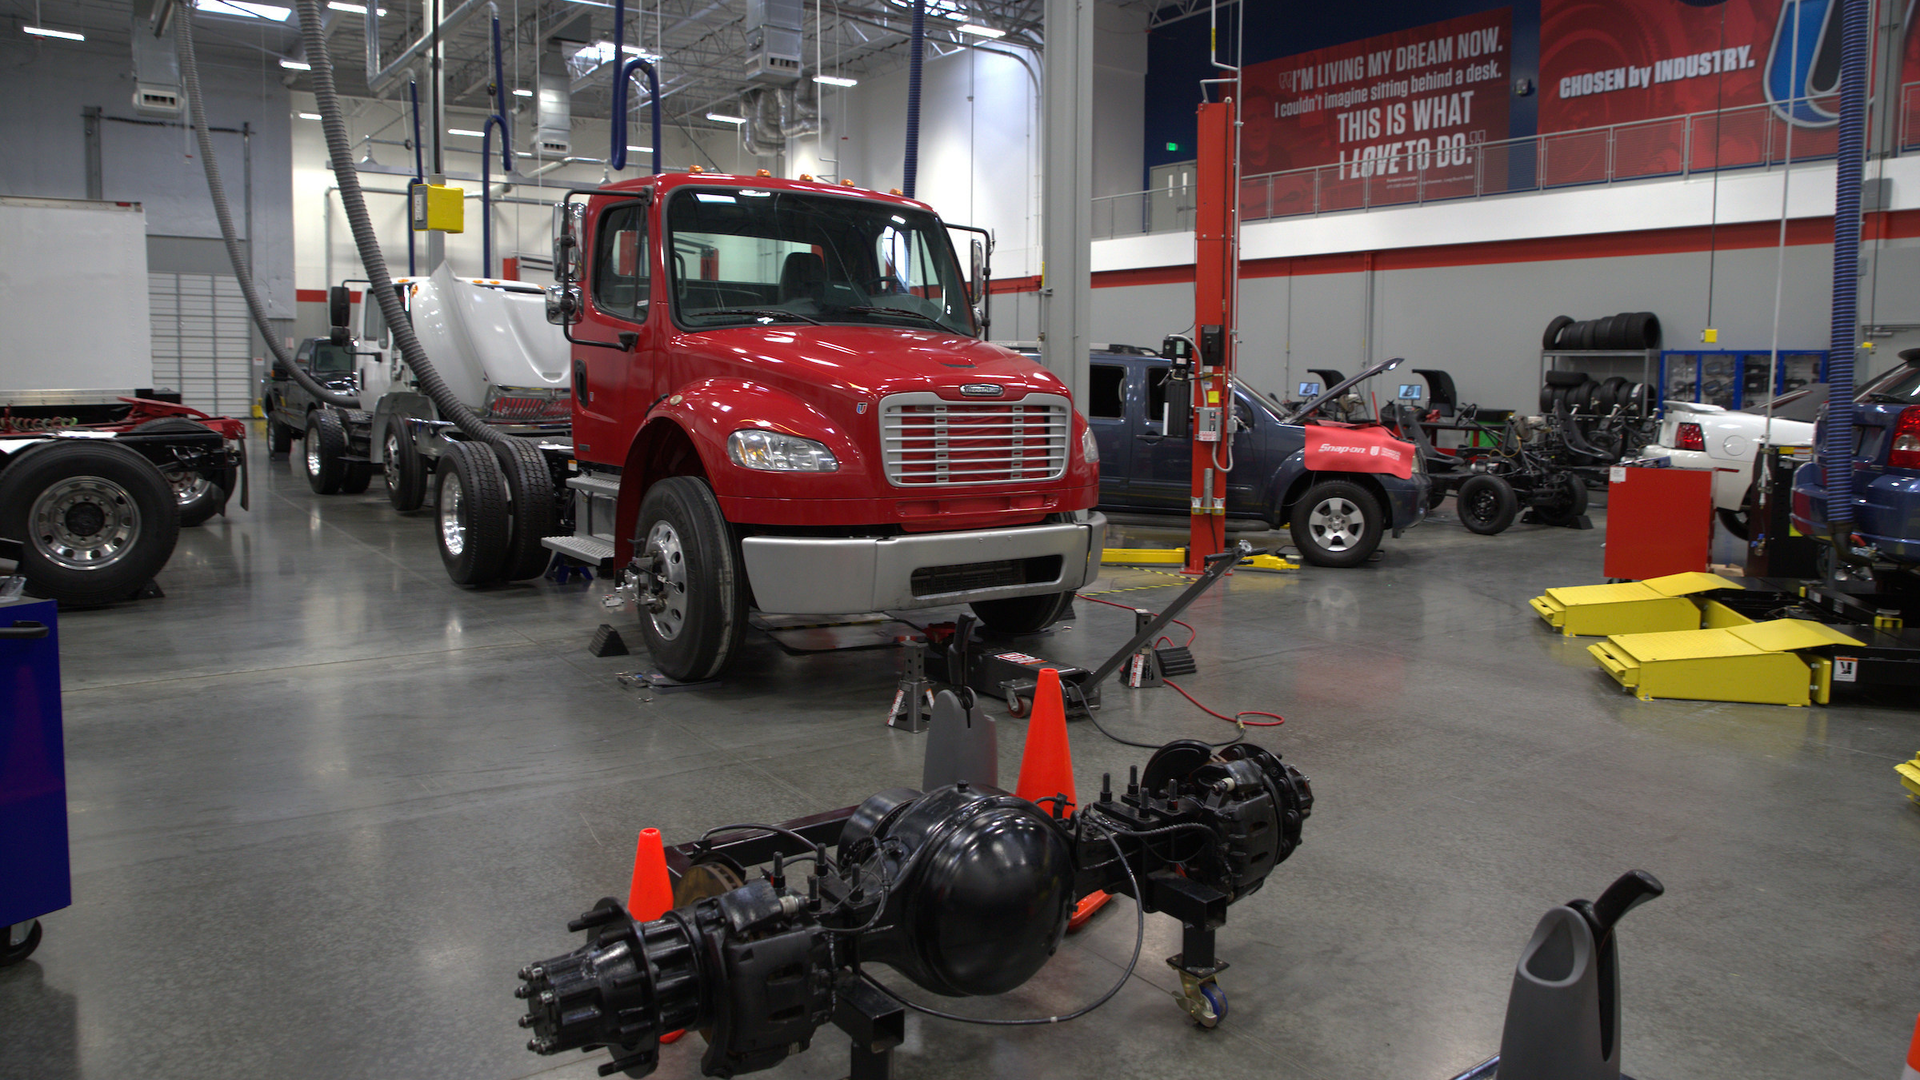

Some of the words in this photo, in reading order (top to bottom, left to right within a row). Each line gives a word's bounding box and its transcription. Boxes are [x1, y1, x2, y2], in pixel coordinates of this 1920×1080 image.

[1317, 56, 1364, 88] LIVING
[1368, 49, 1393, 78] MY
[1396, 36, 1453, 72] DREAM
[1457, 26, 1503, 60] NOW.
[1559, 67, 1626, 99] CHOSEN
[1628, 65, 1653, 89] by
[1654, 44, 1755, 84] INDUSTRY.
[1274, 102, 1279, 118] I
[1280, 94, 1322, 118] couldn't
[1324, 87, 1368, 109] imagine
[1370, 79, 1408, 99] sitting
[1411, 68, 1453, 94] behind
[1455, 70, 1464, 85] a
[1466, 59, 1502, 83] desk.
[1337, 107, 1381, 143] THIS
[1386, 102, 1406, 136] IS
[1412, 90, 1475, 132] WHAT
[1339, 150, 1345, 181] I
[1350, 142, 1402, 179] LOVE
[1404, 138, 1430, 172] TO
[1318, 443, 1366, 454] Snap-on
